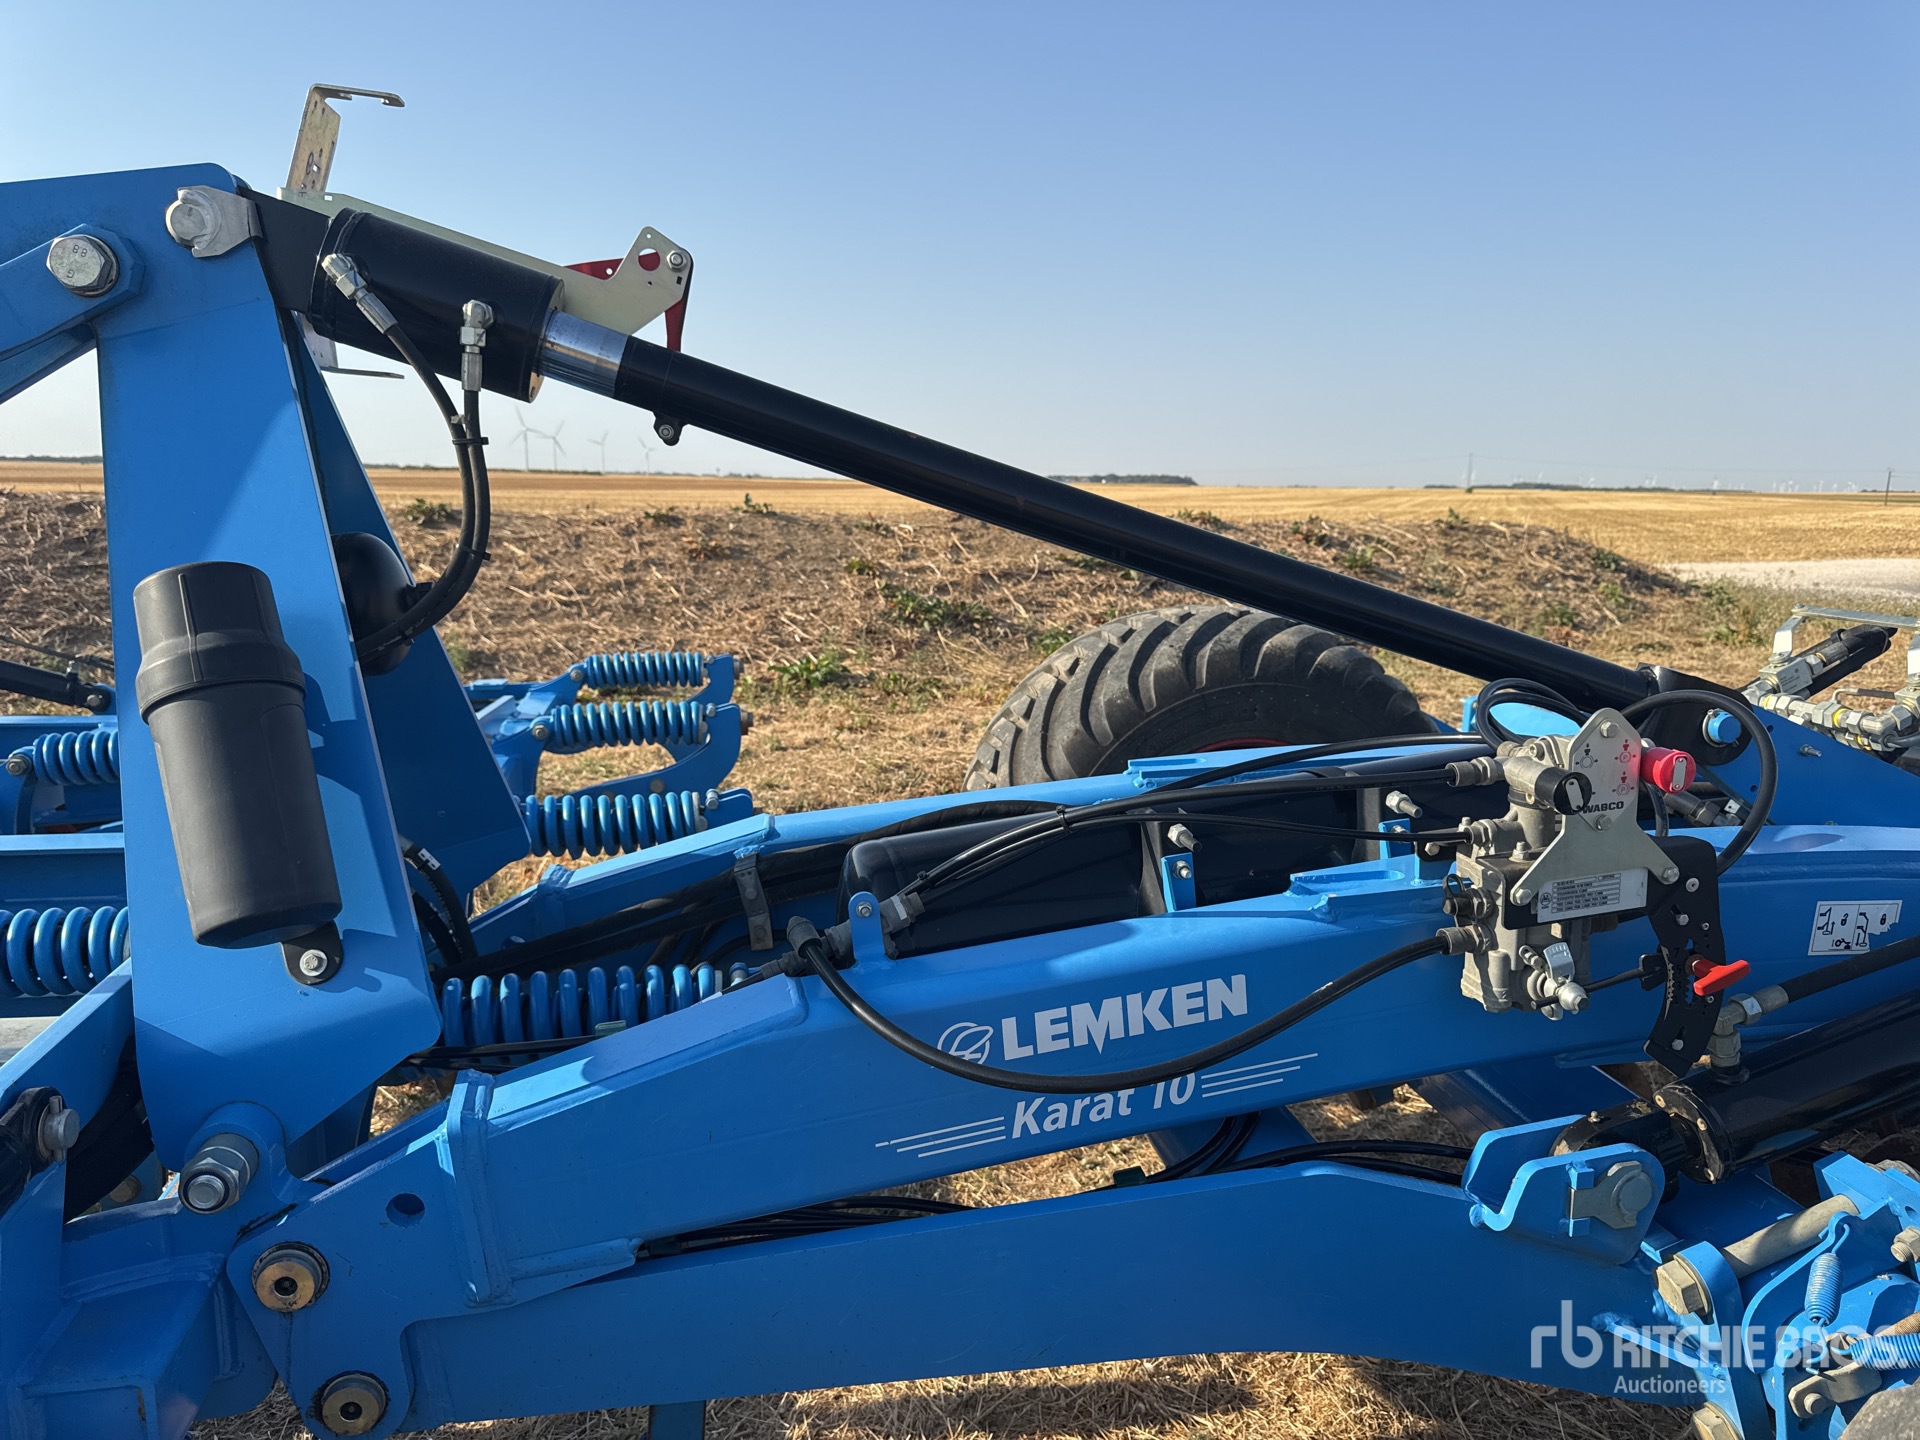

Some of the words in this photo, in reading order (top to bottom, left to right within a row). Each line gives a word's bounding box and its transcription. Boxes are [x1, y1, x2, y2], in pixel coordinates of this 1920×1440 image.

[1583, 801, 1625, 814] WABCO
[1001, 974, 1248, 1061] LEMKEN
[1012, 1087, 1136, 1139] Karat
[1151, 1072, 1196, 1109] 10
